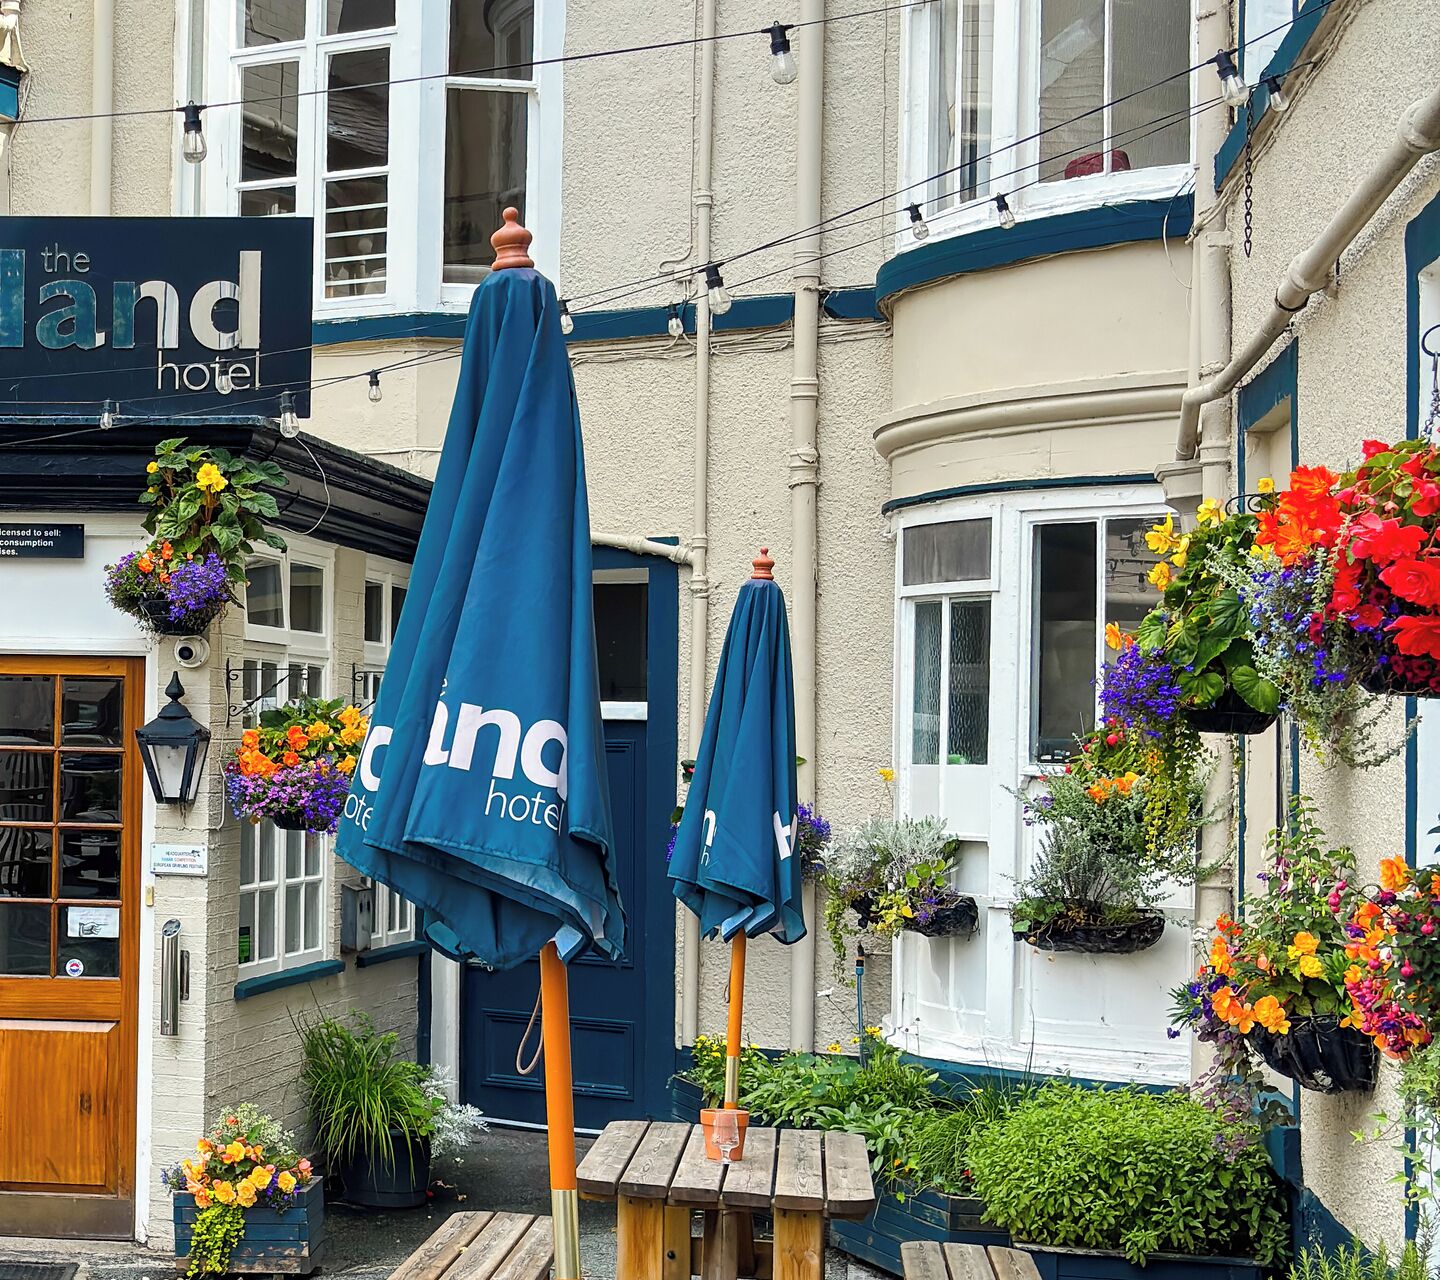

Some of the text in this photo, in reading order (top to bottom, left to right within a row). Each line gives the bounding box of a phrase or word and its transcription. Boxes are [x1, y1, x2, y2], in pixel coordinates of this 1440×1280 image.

[40, 242, 92, 273] the
[157, 350, 261, 392] hotel
[0, 538, 54, 548] consumption
[33, 529, 42, 537] to
[44, 529, 62, 537] sell:
[484, 778, 565, 837] hotel
